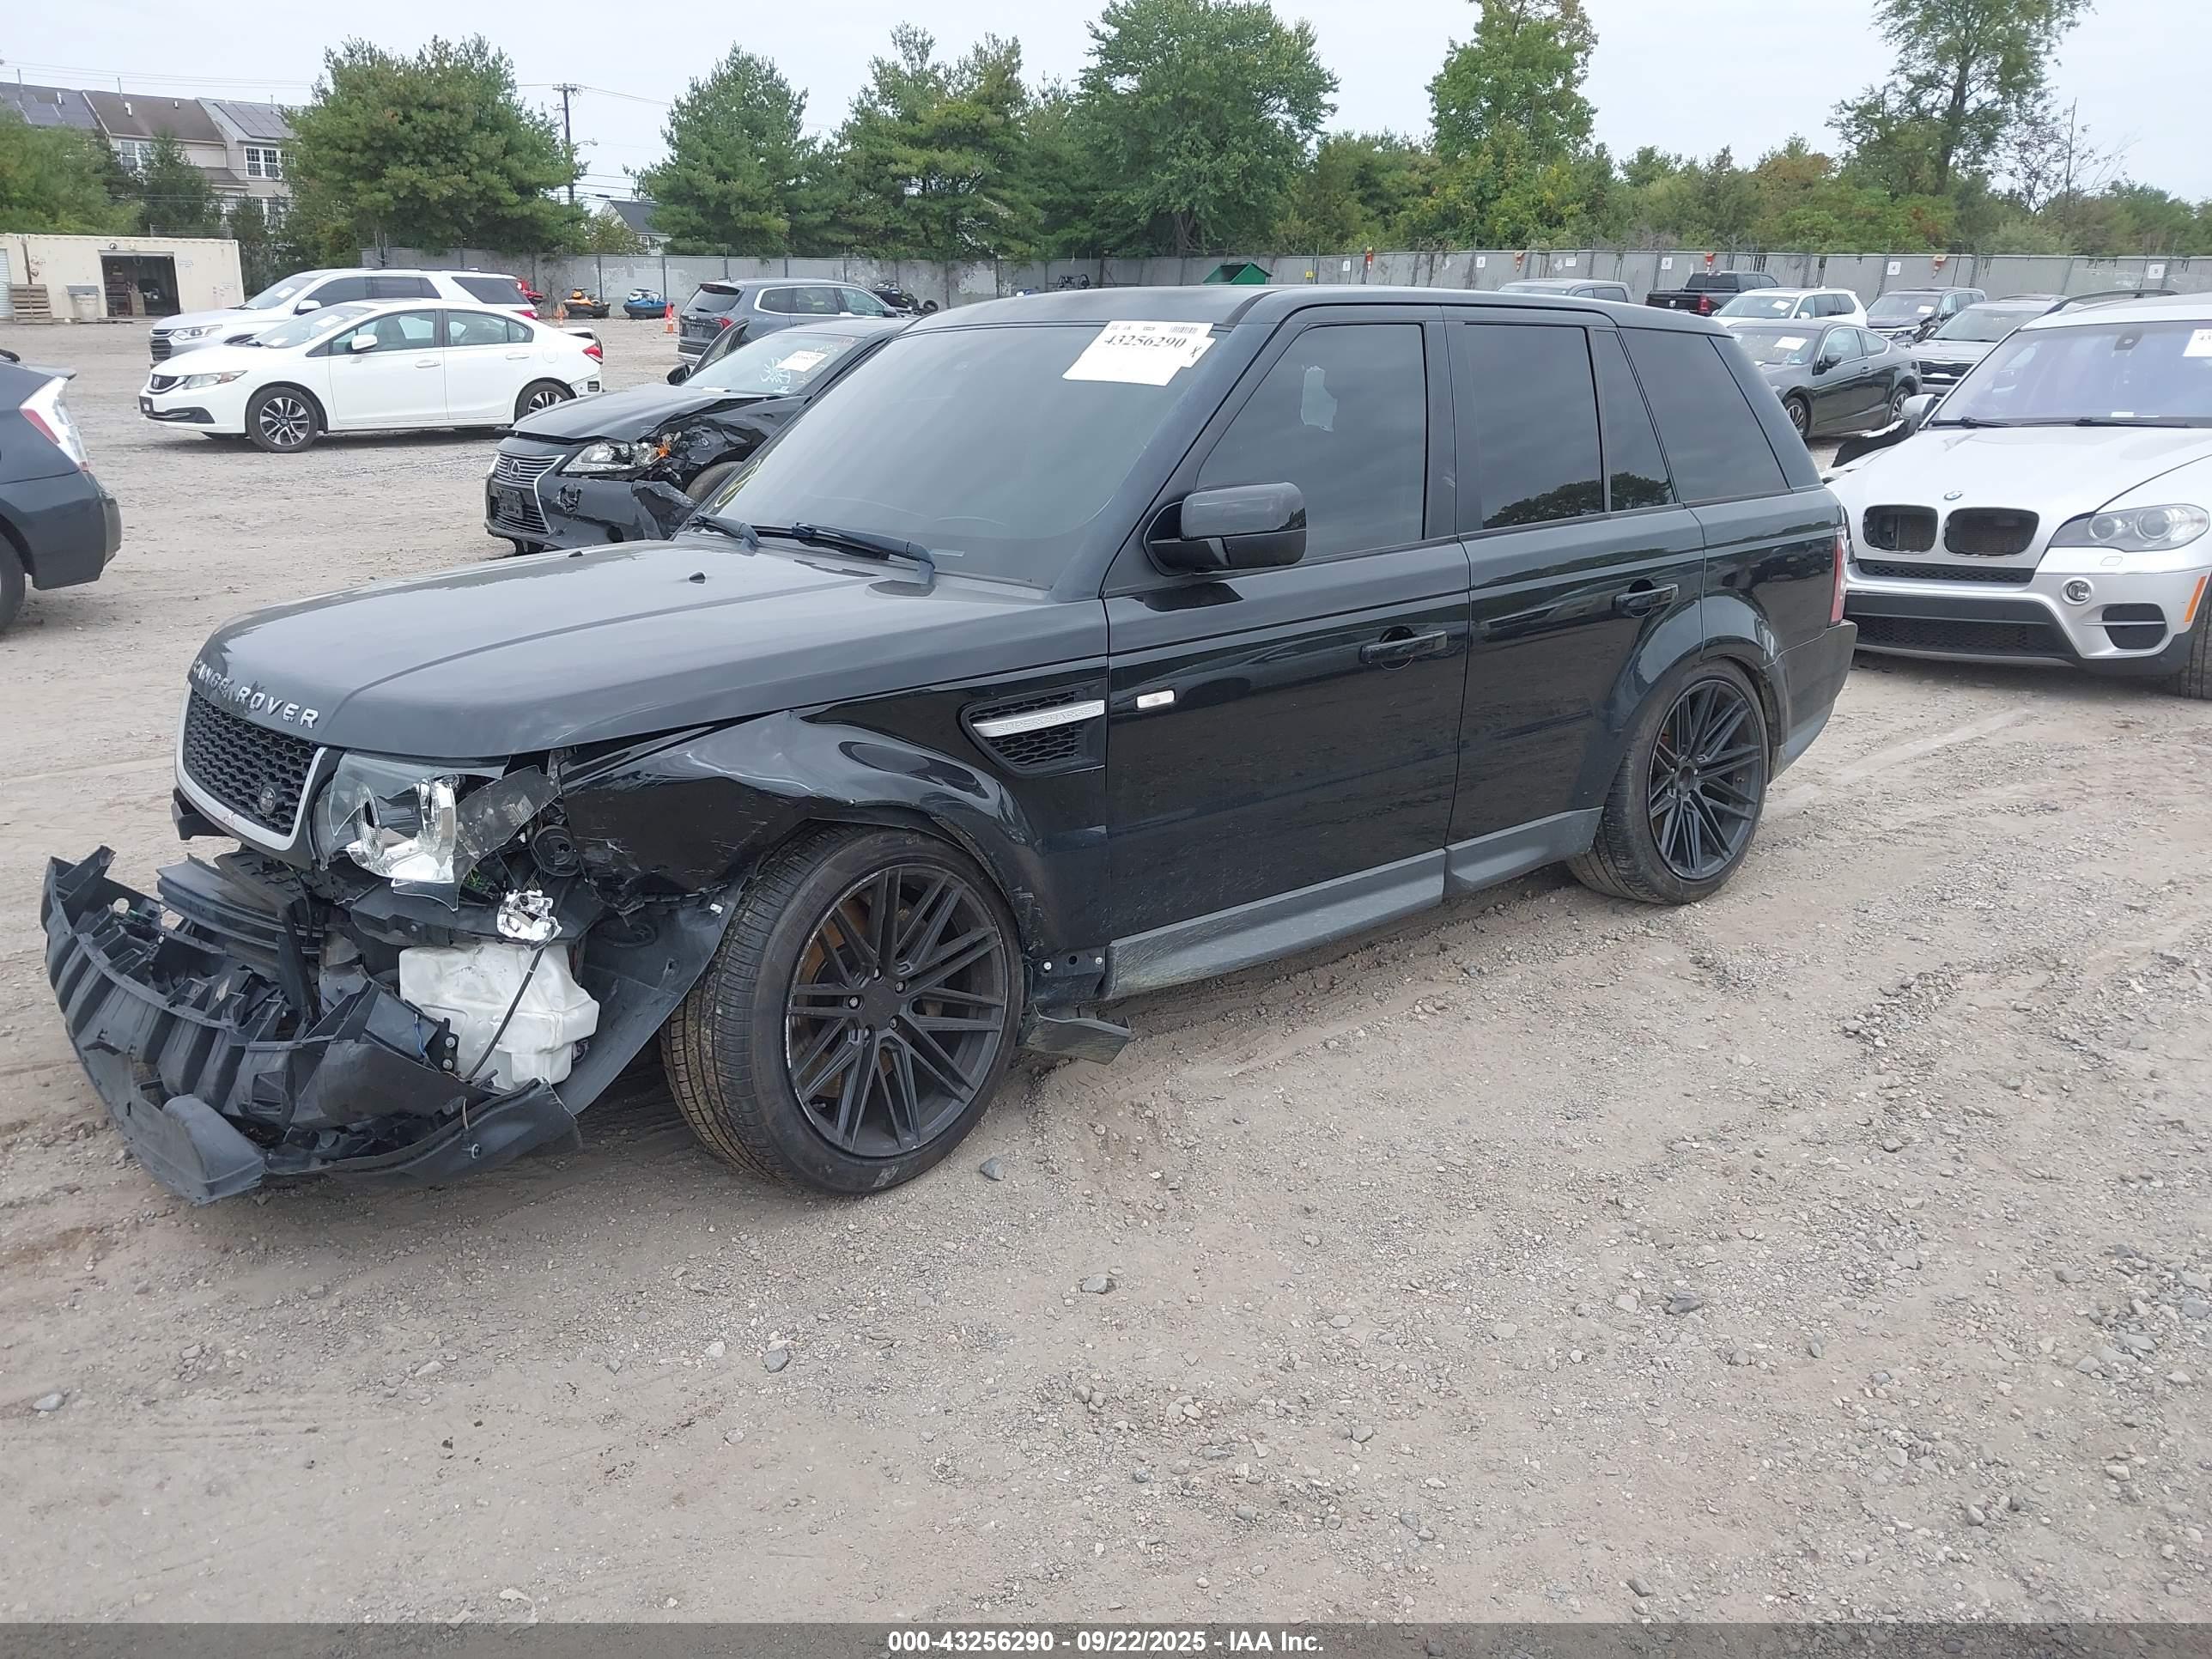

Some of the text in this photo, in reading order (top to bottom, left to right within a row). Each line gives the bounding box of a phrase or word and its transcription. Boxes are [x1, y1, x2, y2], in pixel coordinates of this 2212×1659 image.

[1104, 335, 1187, 348] 43256290
[235, 686, 319, 729] ROVER
[995, 705, 1100, 733] SUPERCHARGED
